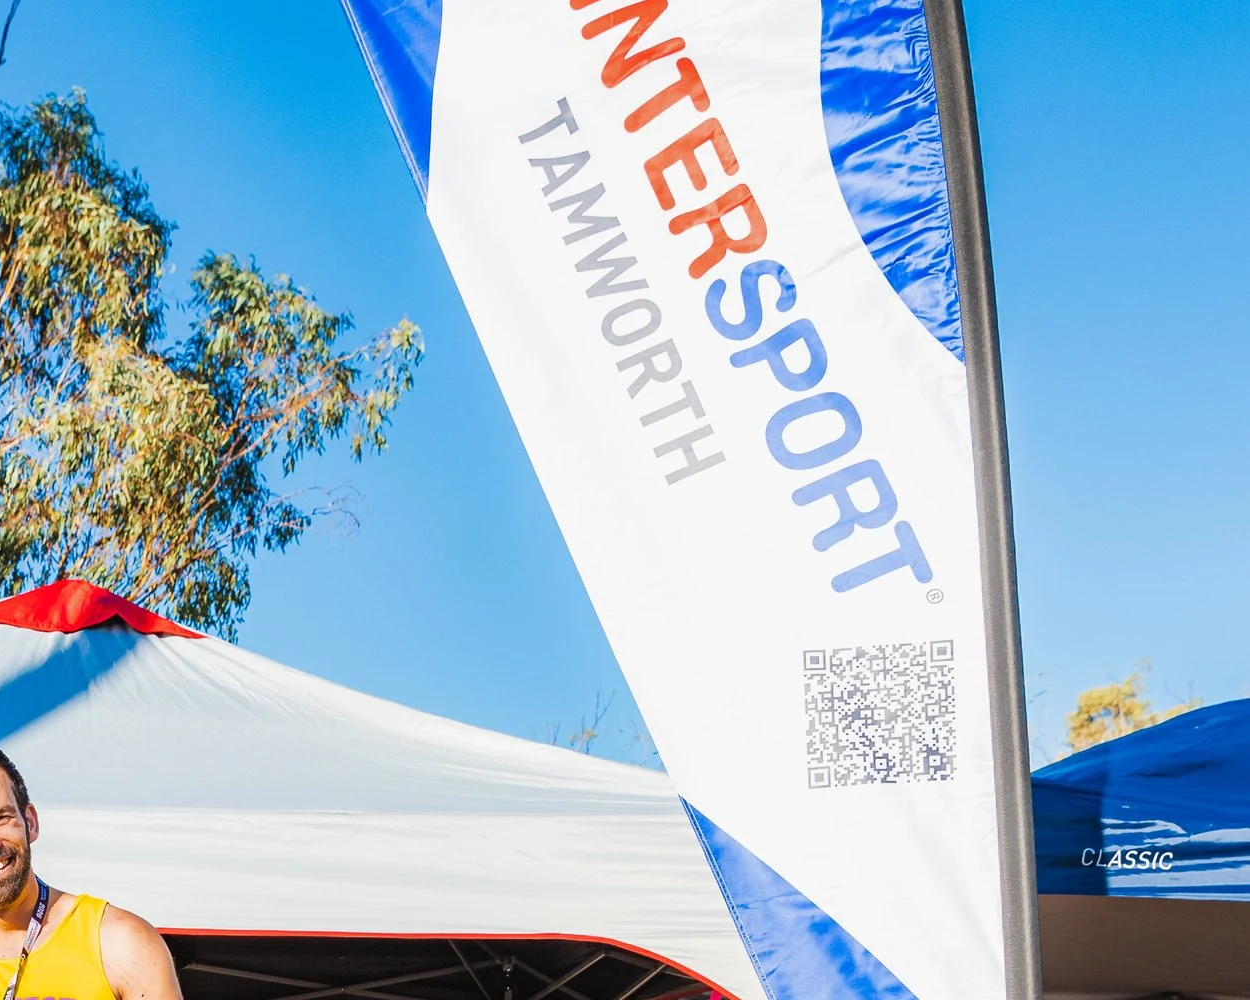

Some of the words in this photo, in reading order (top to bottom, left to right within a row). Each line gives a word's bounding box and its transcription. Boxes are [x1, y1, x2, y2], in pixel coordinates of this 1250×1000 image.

[518, 97, 726, 485] TAMWORTH
[570, 0, 933, 593] NTERSPORT
[1081, 848, 1174, 870] CLASSIC
